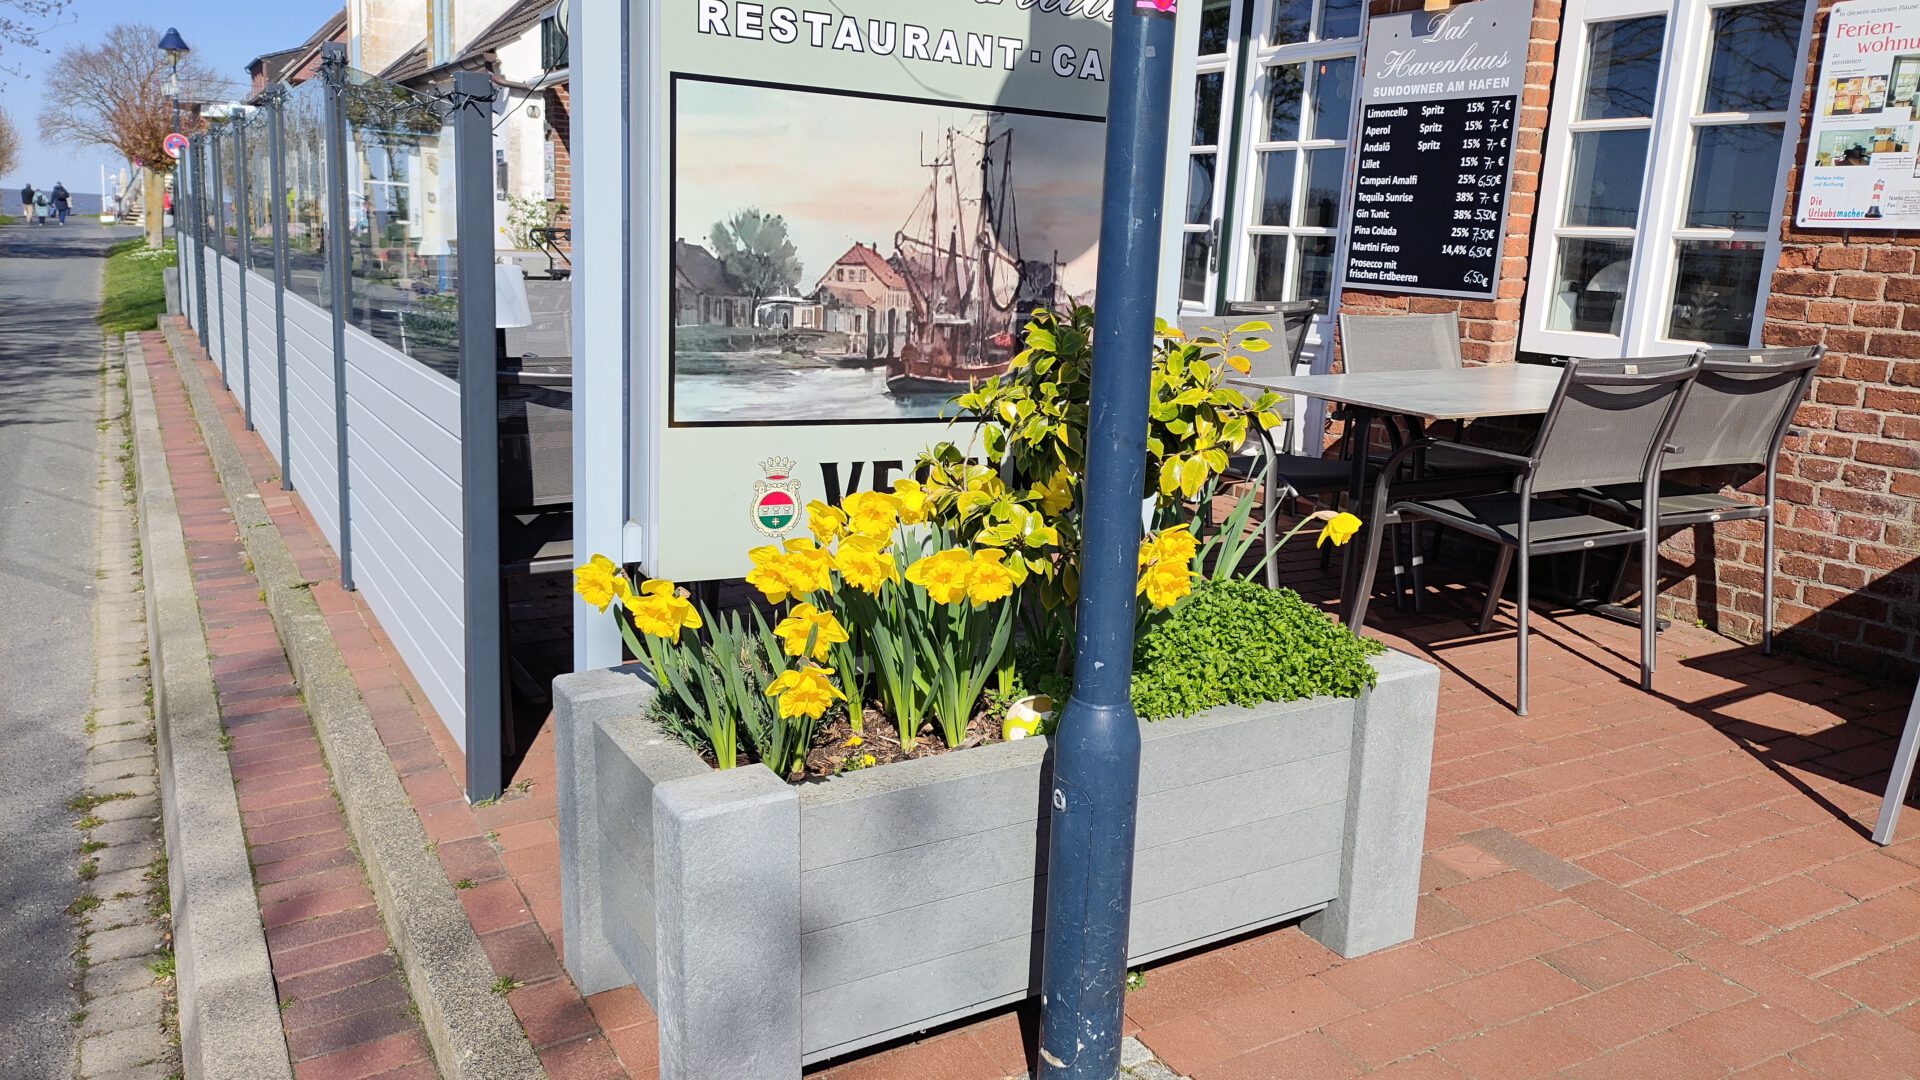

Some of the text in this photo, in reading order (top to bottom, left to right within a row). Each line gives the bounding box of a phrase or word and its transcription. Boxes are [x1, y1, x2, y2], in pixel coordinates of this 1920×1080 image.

[1422, 13, 1475, 44] Dat
[1836, 20, 1902, 39] Ferien-
[698, 0, 1023, 71] RESTAURANT
[1052, 44, 1105, 82] CA
[1376, 42, 1512, 80] Havenhuus
[1373, 76, 1510, 97] SUNDOWNER AM HAFEN
[1367, 106, 1408, 118] Limoncello
[1421, 105, 1444, 117] Spritz
[1466, 102, 1485, 113] 15%
[1365, 125, 1391, 136] Aperol
[1419, 123, 1443, 135] Spritz
[1464, 120, 1483, 131] 15%
[1417, 140, 1441, 152] Spritz
[1462, 138, 1480, 149] 15%
[1361, 159, 1380, 170] Lillet
[1460, 156, 1479, 167] 15%
[1360, 176, 1391, 187] Campari
[1392, 174, 1418, 186] Amalfi
[1457, 174, 1476, 185] 25%
[1358, 192, 1385, 204] Tequila
[1385, 193, 1414, 203] Sunrise
[1455, 192, 1474, 202] 38%
[1810, 196, 1823, 206] Die
[1356, 209, 1370, 219] Gin
[1453, 209, 1472, 220] 38%
[1808, 208, 1865, 218] Urlaubsmacher
[1354, 225, 1371, 236] Pina
[1371, 226, 1397, 237] Colada
[1451, 227, 1469, 237] 25%
[1352, 242, 1380, 252] Martini
[1380, 243, 1400, 254] Fiero
[1441, 244, 1467, 256] 14,4%
[1350, 258, 1397, 270] Prosecco mit
[1349, 268, 1378, 280] frischen
[1379, 270, 1418, 283] Erdbeeren
